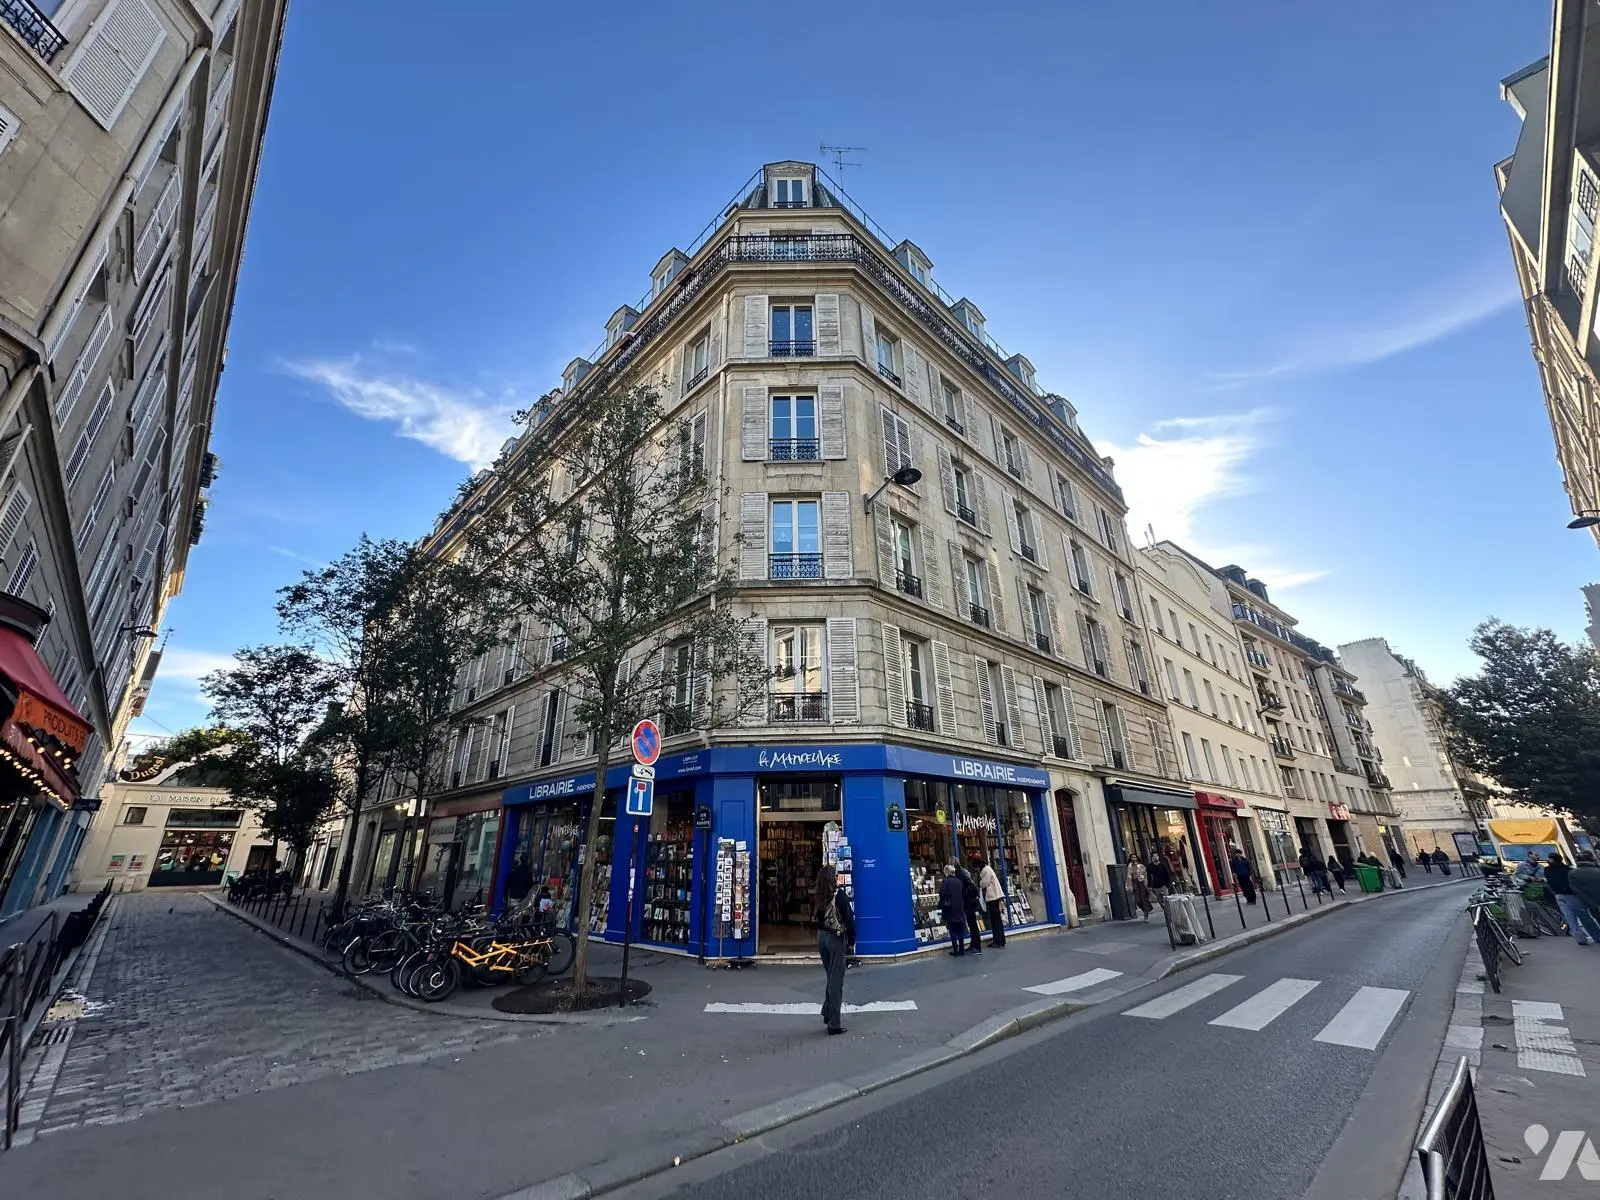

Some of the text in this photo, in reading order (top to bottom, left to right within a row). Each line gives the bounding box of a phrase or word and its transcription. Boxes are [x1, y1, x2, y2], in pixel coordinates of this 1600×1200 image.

[43, 709, 80, 743] PRODUITS
[953, 759, 1017, 782] LIBRAIRIE
[168, 794, 203, 803] MAISON
[529, 779, 576, 799] LIBRAIRIE
